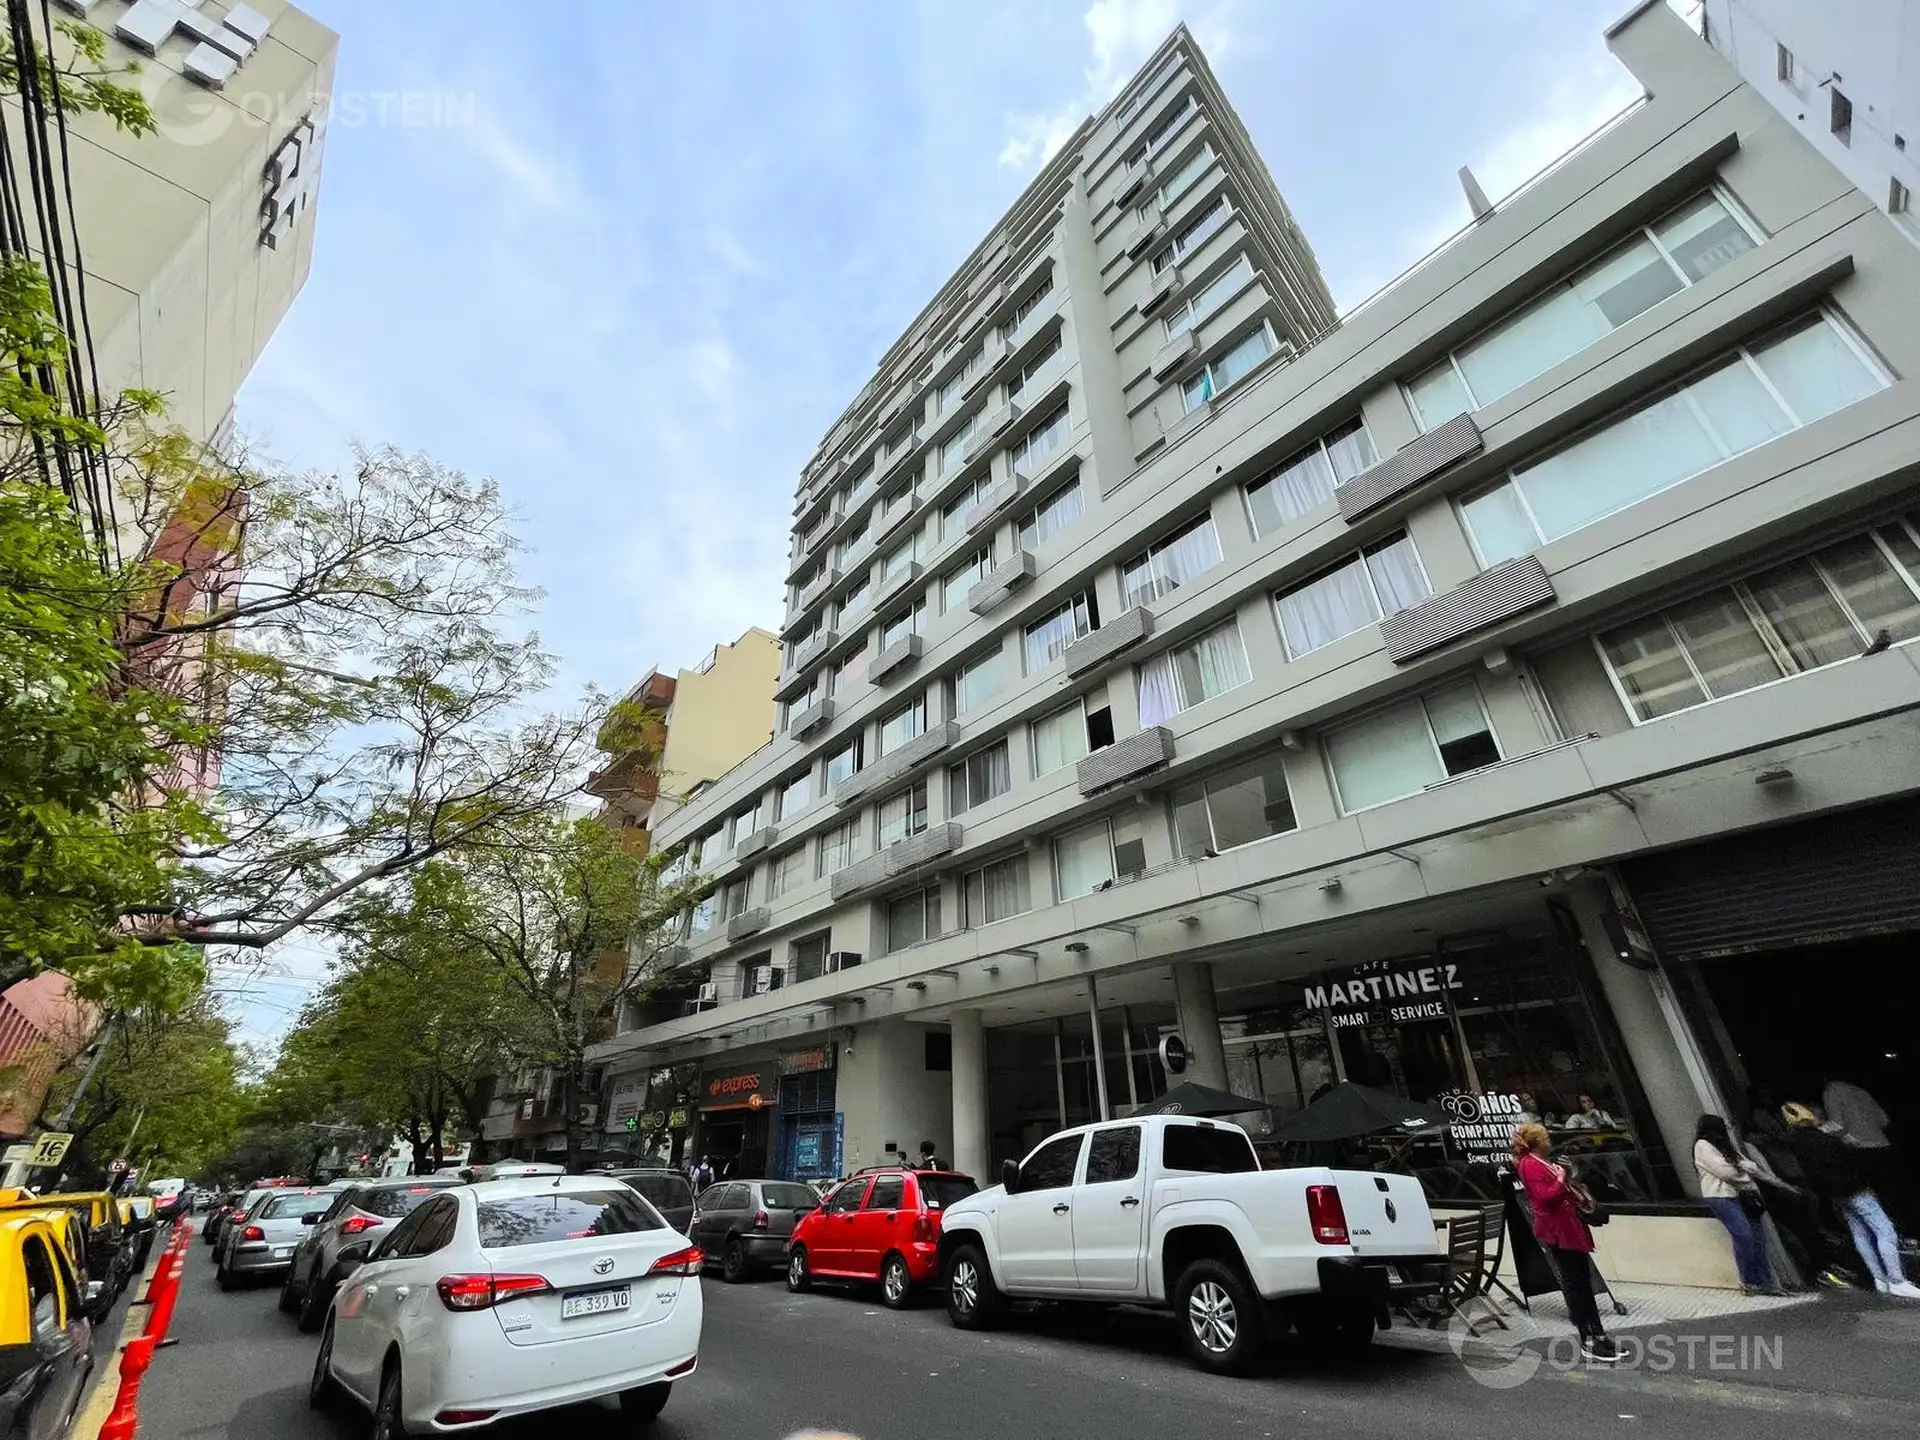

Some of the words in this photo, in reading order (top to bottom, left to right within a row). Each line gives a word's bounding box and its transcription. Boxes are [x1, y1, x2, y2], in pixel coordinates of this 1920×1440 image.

[1353, 961, 1389, 975] CAFE
[1303, 963, 1464, 1010] MARTINEZ
[1331, 1012, 1369, 1028] SMART
[1391, 1002, 1445, 1021] SERVICE
[1479, 1091, 1522, 1114] AÑOS
[40, 1141, 65, 1157] 16
[1468, 1140, 1493, 1148] VAMOS
[1493, 1139, 1508, 1148] POR
[586, 1296, 609, 1312] 339
